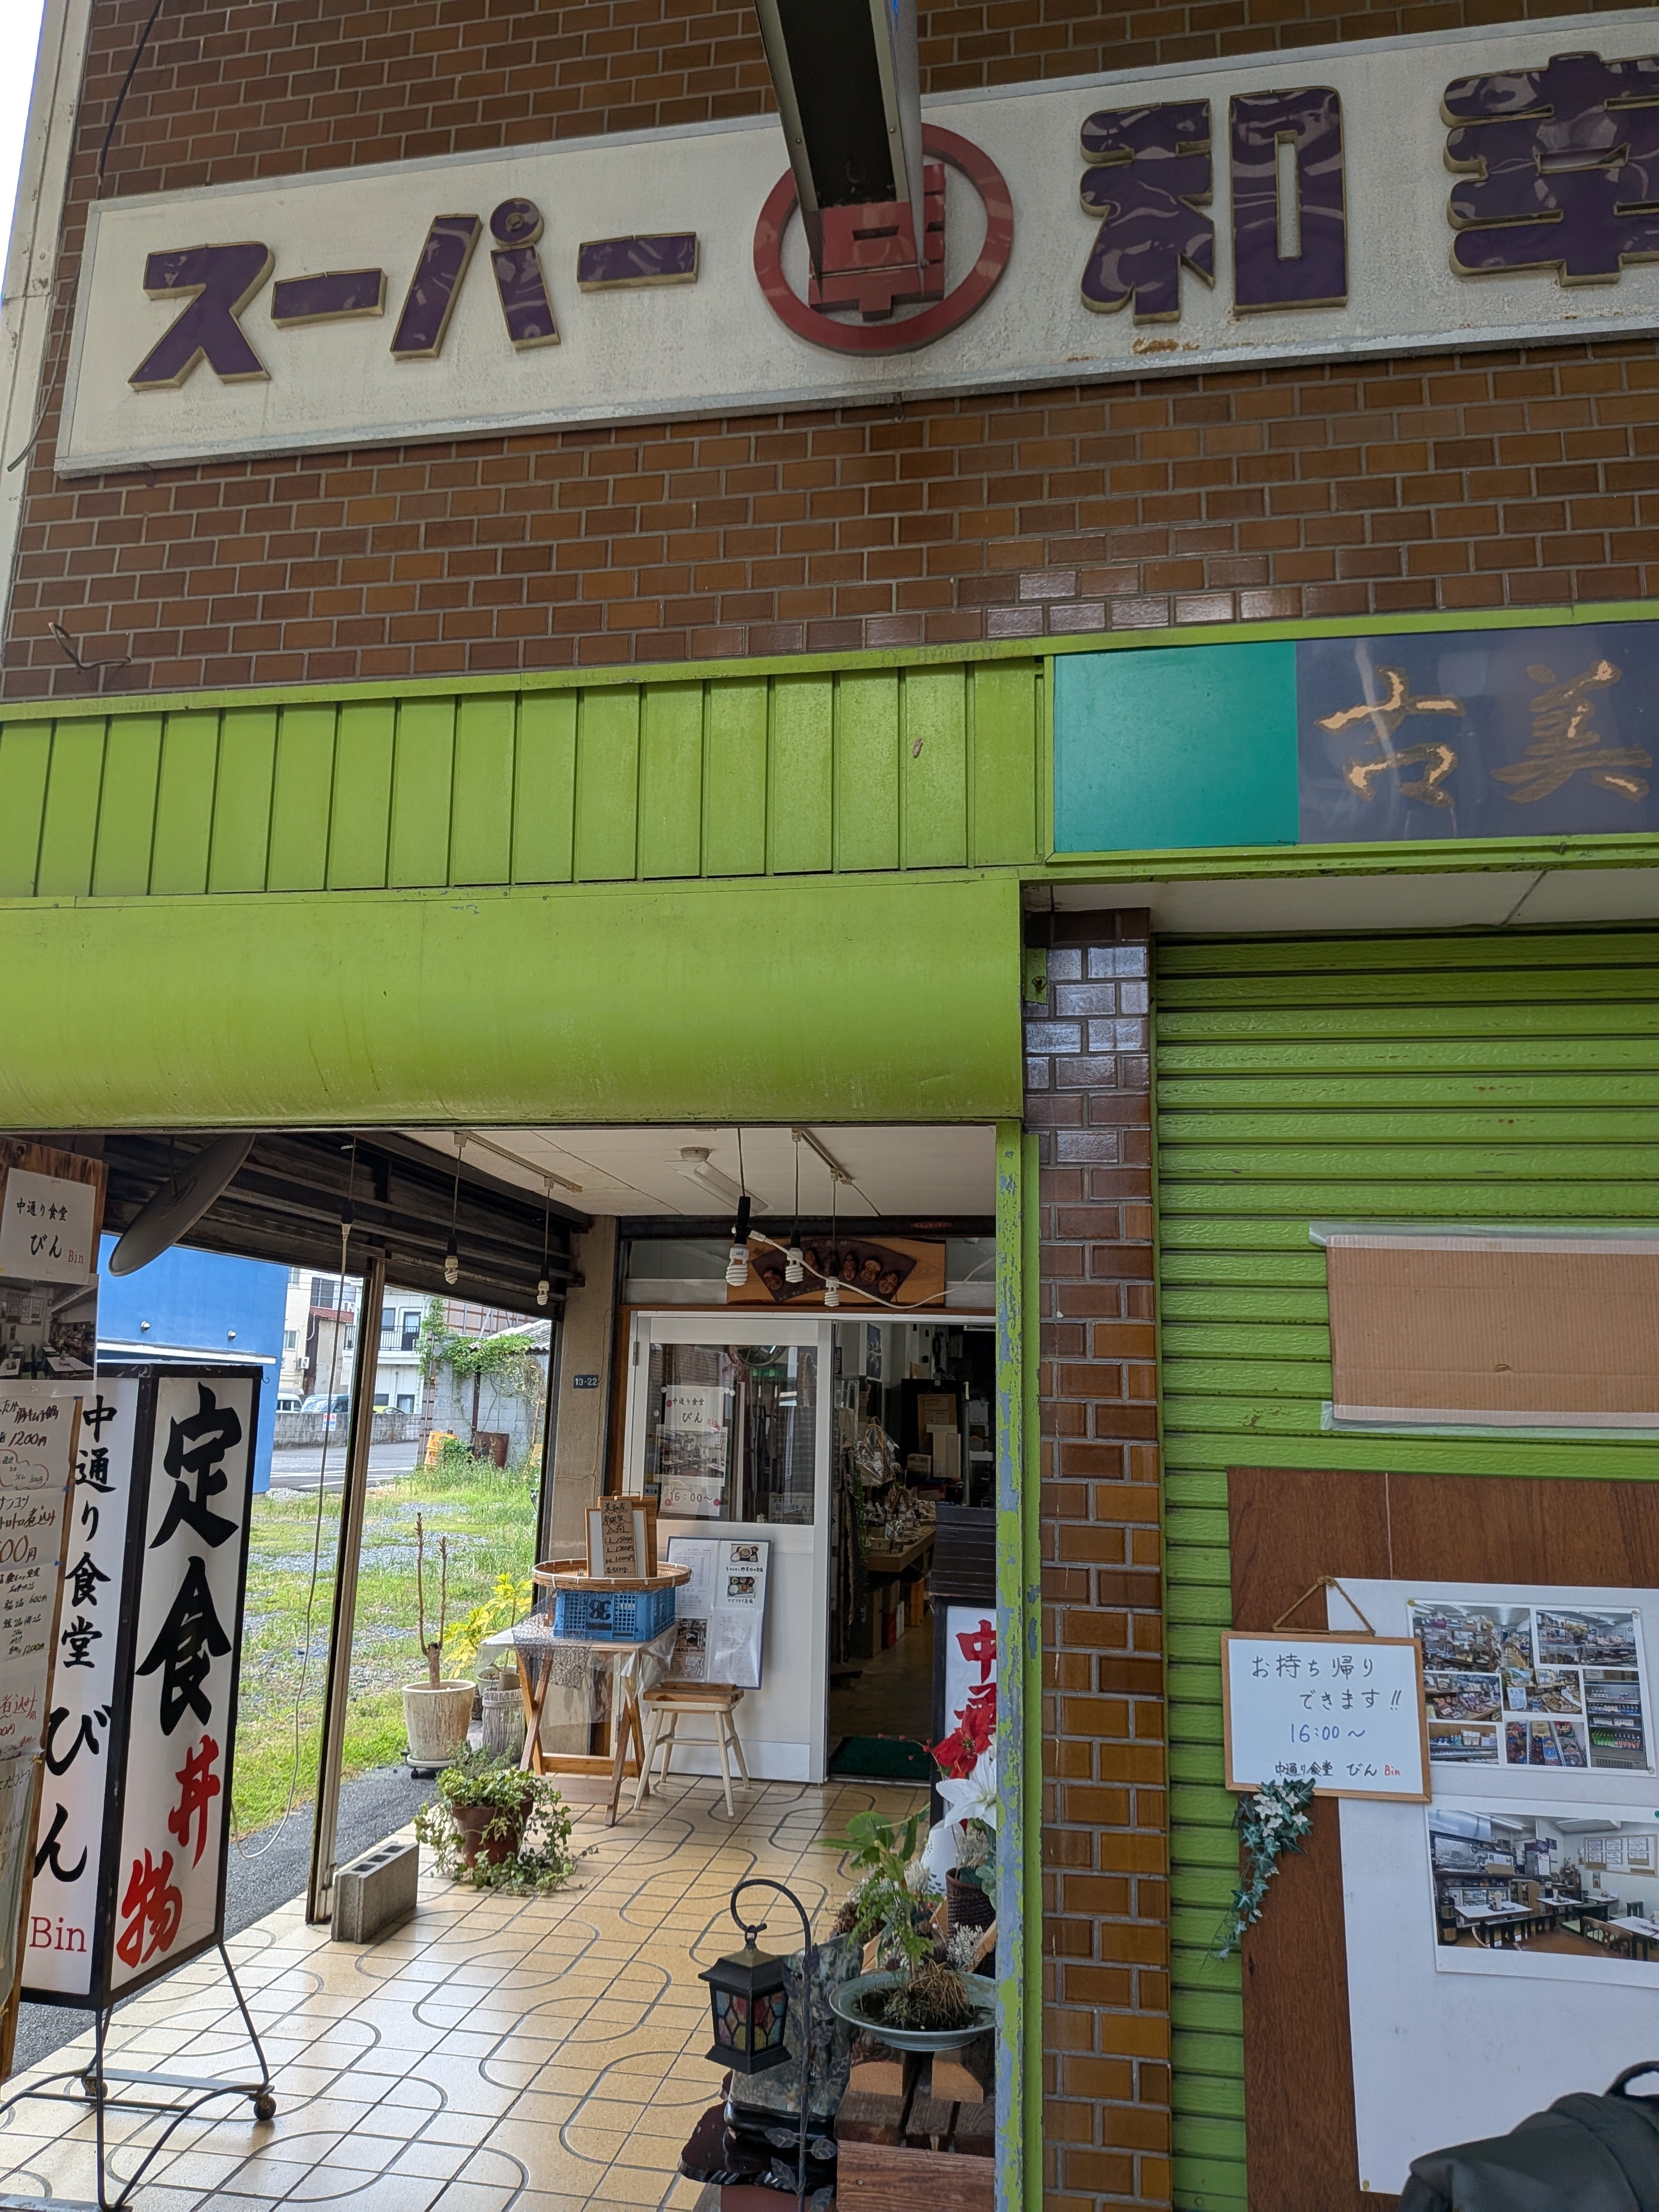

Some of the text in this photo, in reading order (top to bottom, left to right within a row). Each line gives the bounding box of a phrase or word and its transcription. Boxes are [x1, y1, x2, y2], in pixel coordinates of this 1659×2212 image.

[127, 197, 700, 392] スーパー
[16, 1197, 68, 1221] 中通り食堂
[30, 1233, 84, 1264] びん Bin
[575, 1378, 598, 1386] 13-22
[672, 1397, 705, 1406] 中通り食堂
[682, 1411, 703, 1423] びん
[61, 1395, 117, 1669] 中通り食堂
[0, 1535, 37, 1564] 00円
[134, 1381, 242, 1736] 定食
[1252, 1653, 1374, 1680] お持ち帰り
[1274, 1760, 1401, 1777] 中通り食堂 びん Bin
[116, 1734, 221, 1969] 丼物
[29, 1916, 87, 1953] Bin
